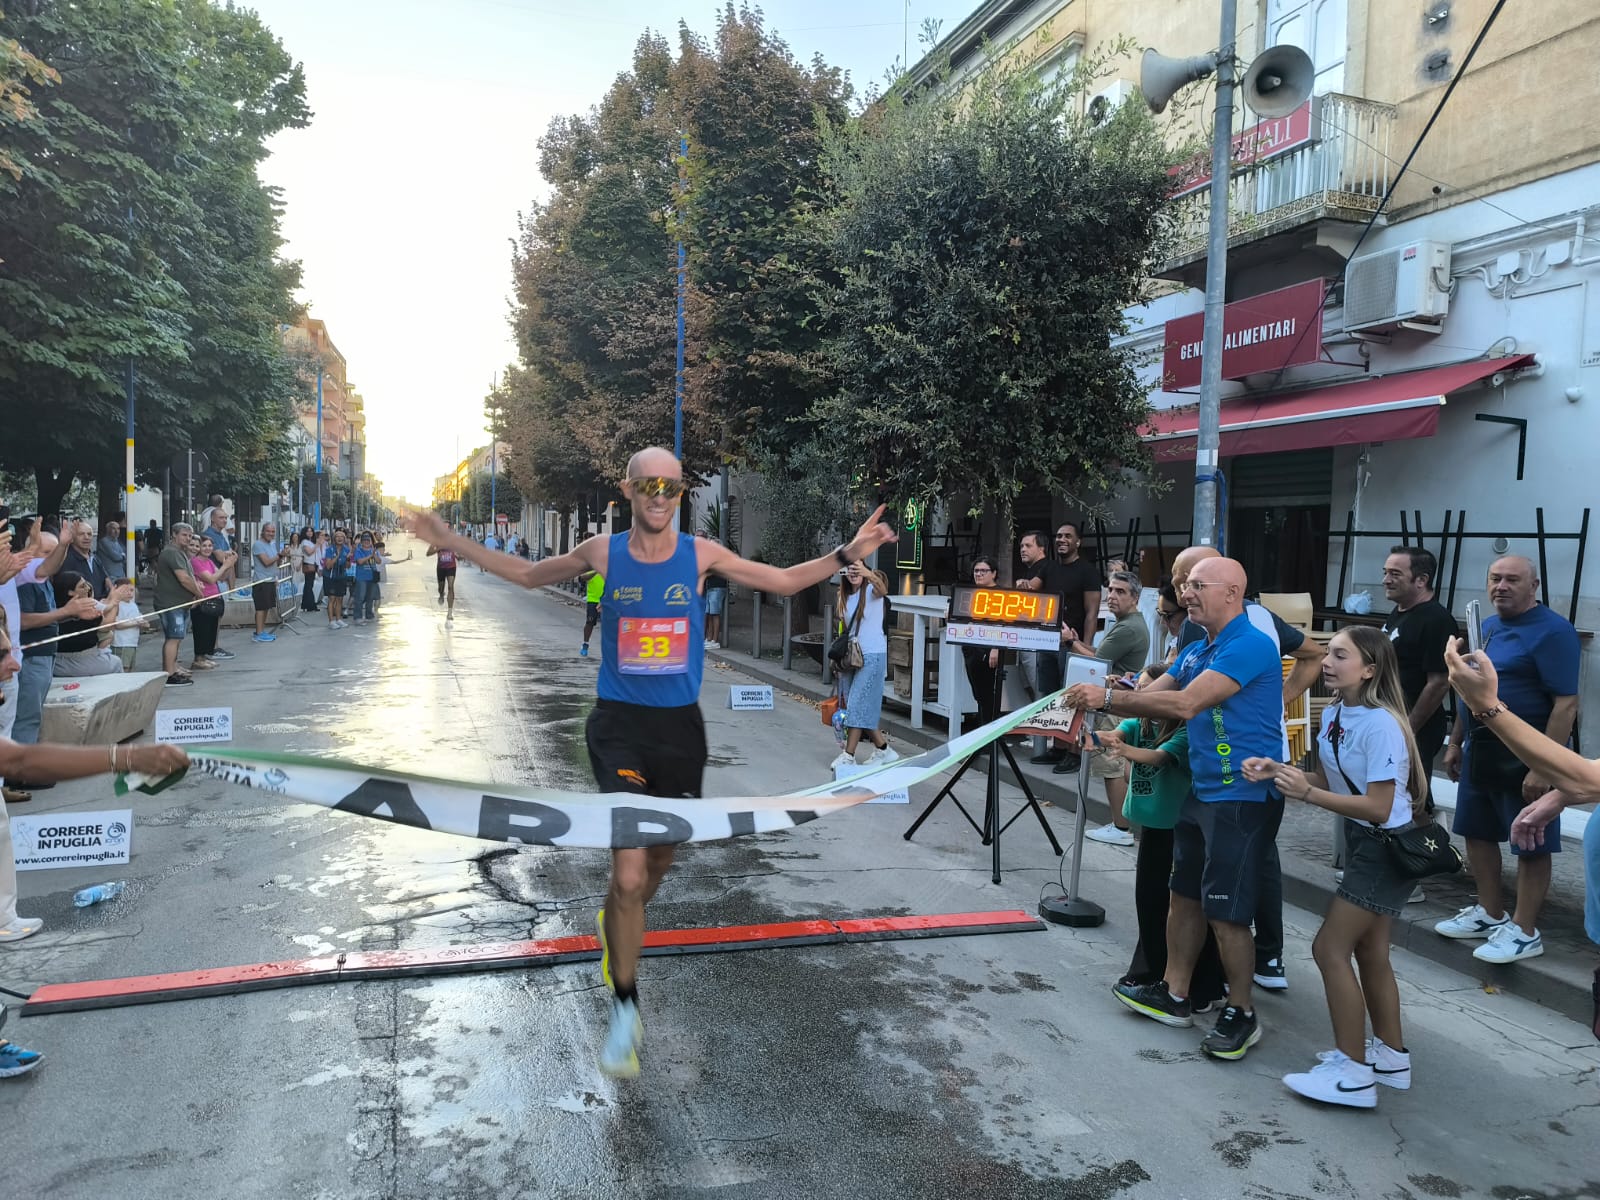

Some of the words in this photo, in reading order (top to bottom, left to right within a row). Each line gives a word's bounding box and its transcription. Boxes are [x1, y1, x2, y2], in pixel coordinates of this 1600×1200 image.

[1224, 318, 1296, 350] ALIMENTARI
[639, 636, 671, 658] 33
[173, 716, 215, 725] CORRERE
[184, 723, 214, 732] PUGLIA
[38, 825, 103, 838] CORRERE
[37, 840, 52, 850] IN
[53, 837, 102, 849] PUGLIA
